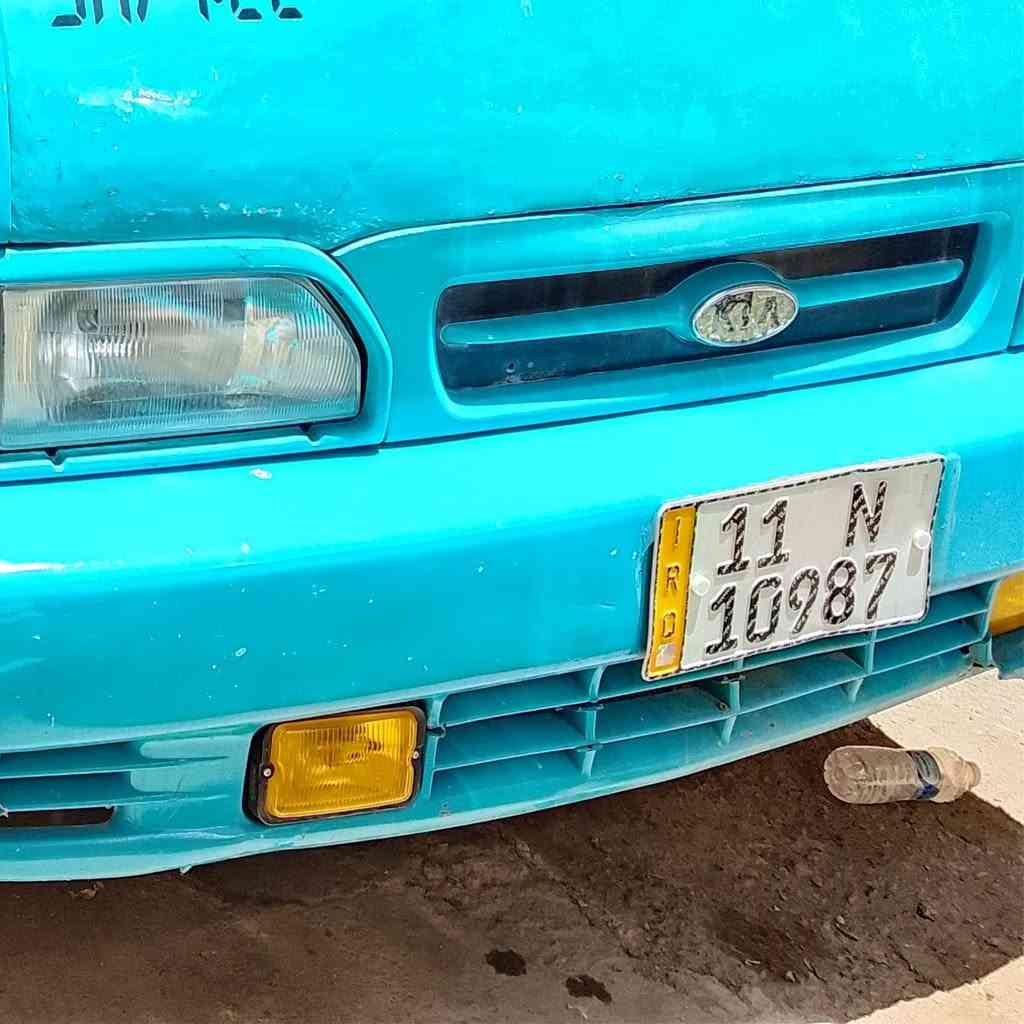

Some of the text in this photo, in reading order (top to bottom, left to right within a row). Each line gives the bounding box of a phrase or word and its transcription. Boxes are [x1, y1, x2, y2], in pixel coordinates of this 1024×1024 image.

[717, 479, 889, 576] 11 N
[705, 547, 899, 656] 10987
